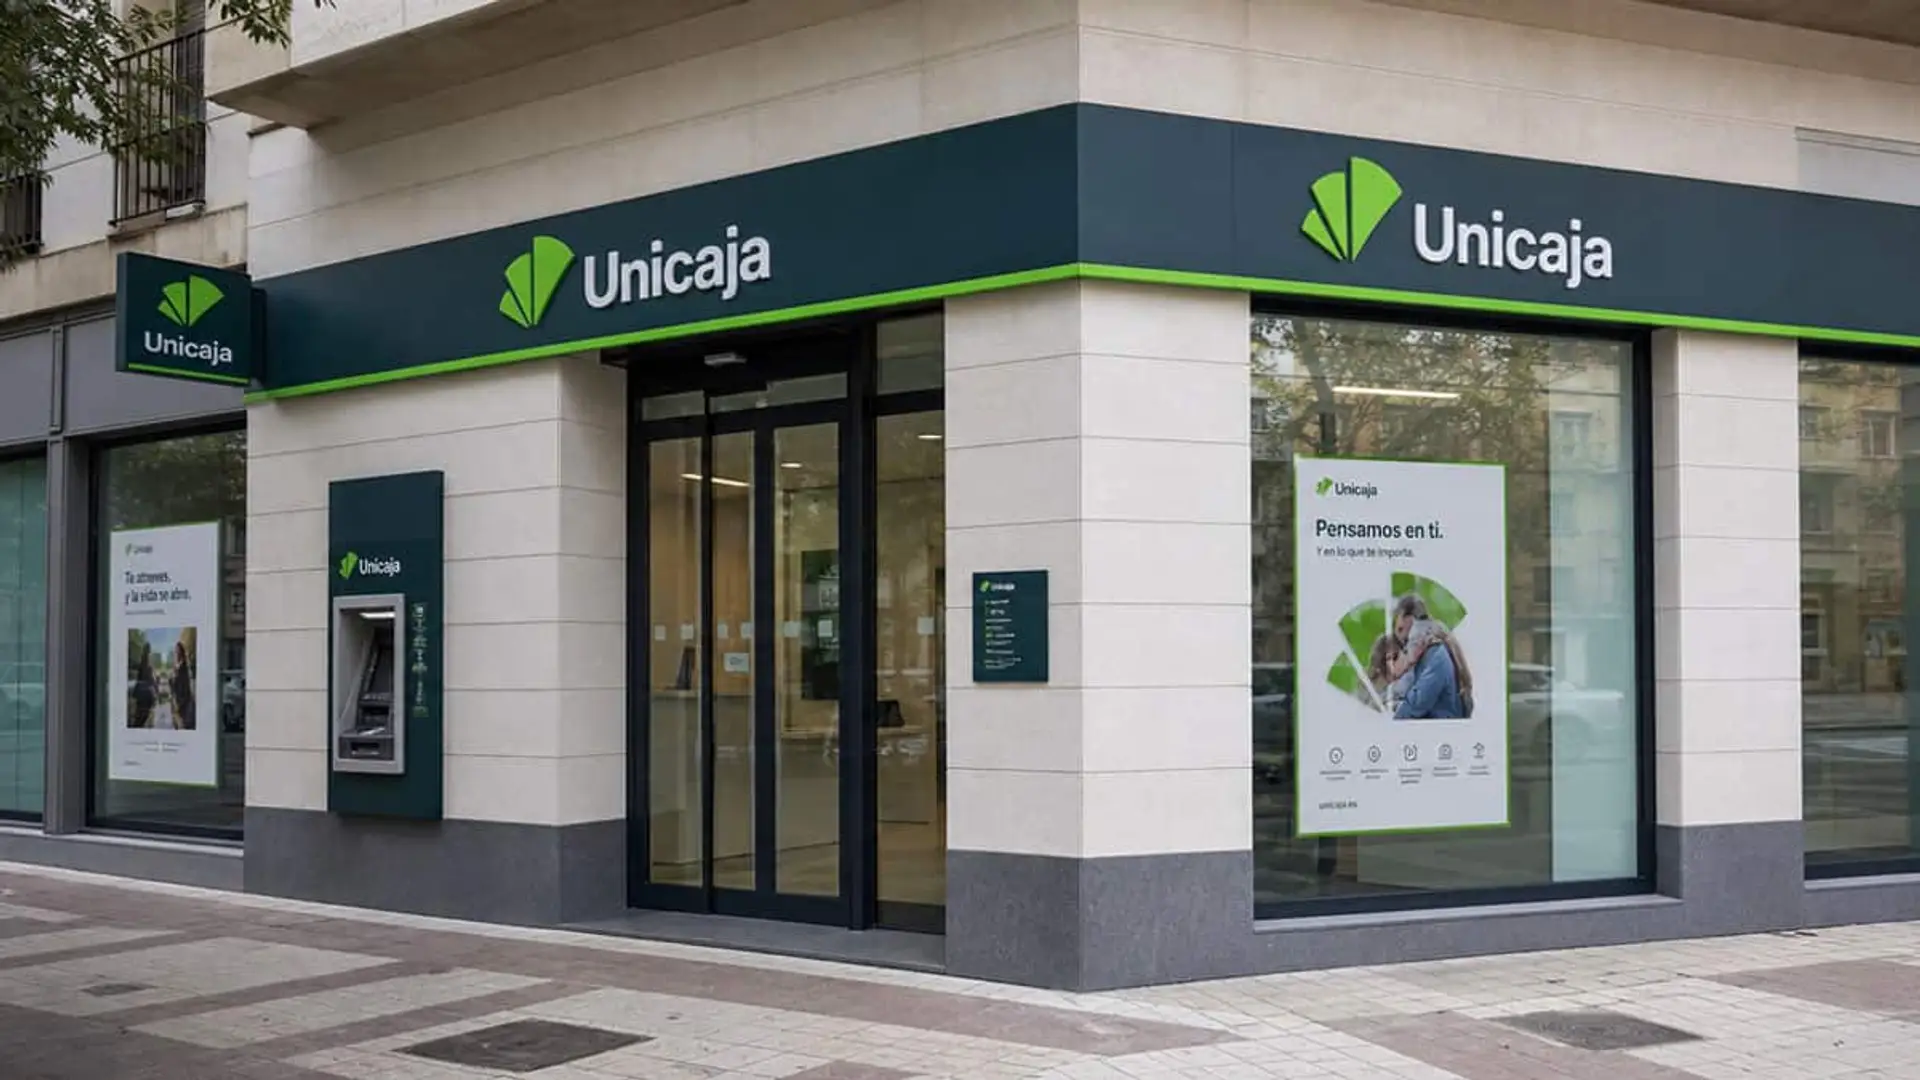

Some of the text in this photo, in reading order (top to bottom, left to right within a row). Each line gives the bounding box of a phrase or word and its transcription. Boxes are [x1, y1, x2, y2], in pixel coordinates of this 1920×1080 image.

[1414, 203, 1613, 288] Unicaja
[584, 224, 770, 308] Unicaja
[144, 330, 232, 366] Unicaja
[1335, 481, 1378, 498] Unicaja
[1316, 519, 1443, 539] Pensamos en ti.
[359, 556, 401, 577] Unicaja
